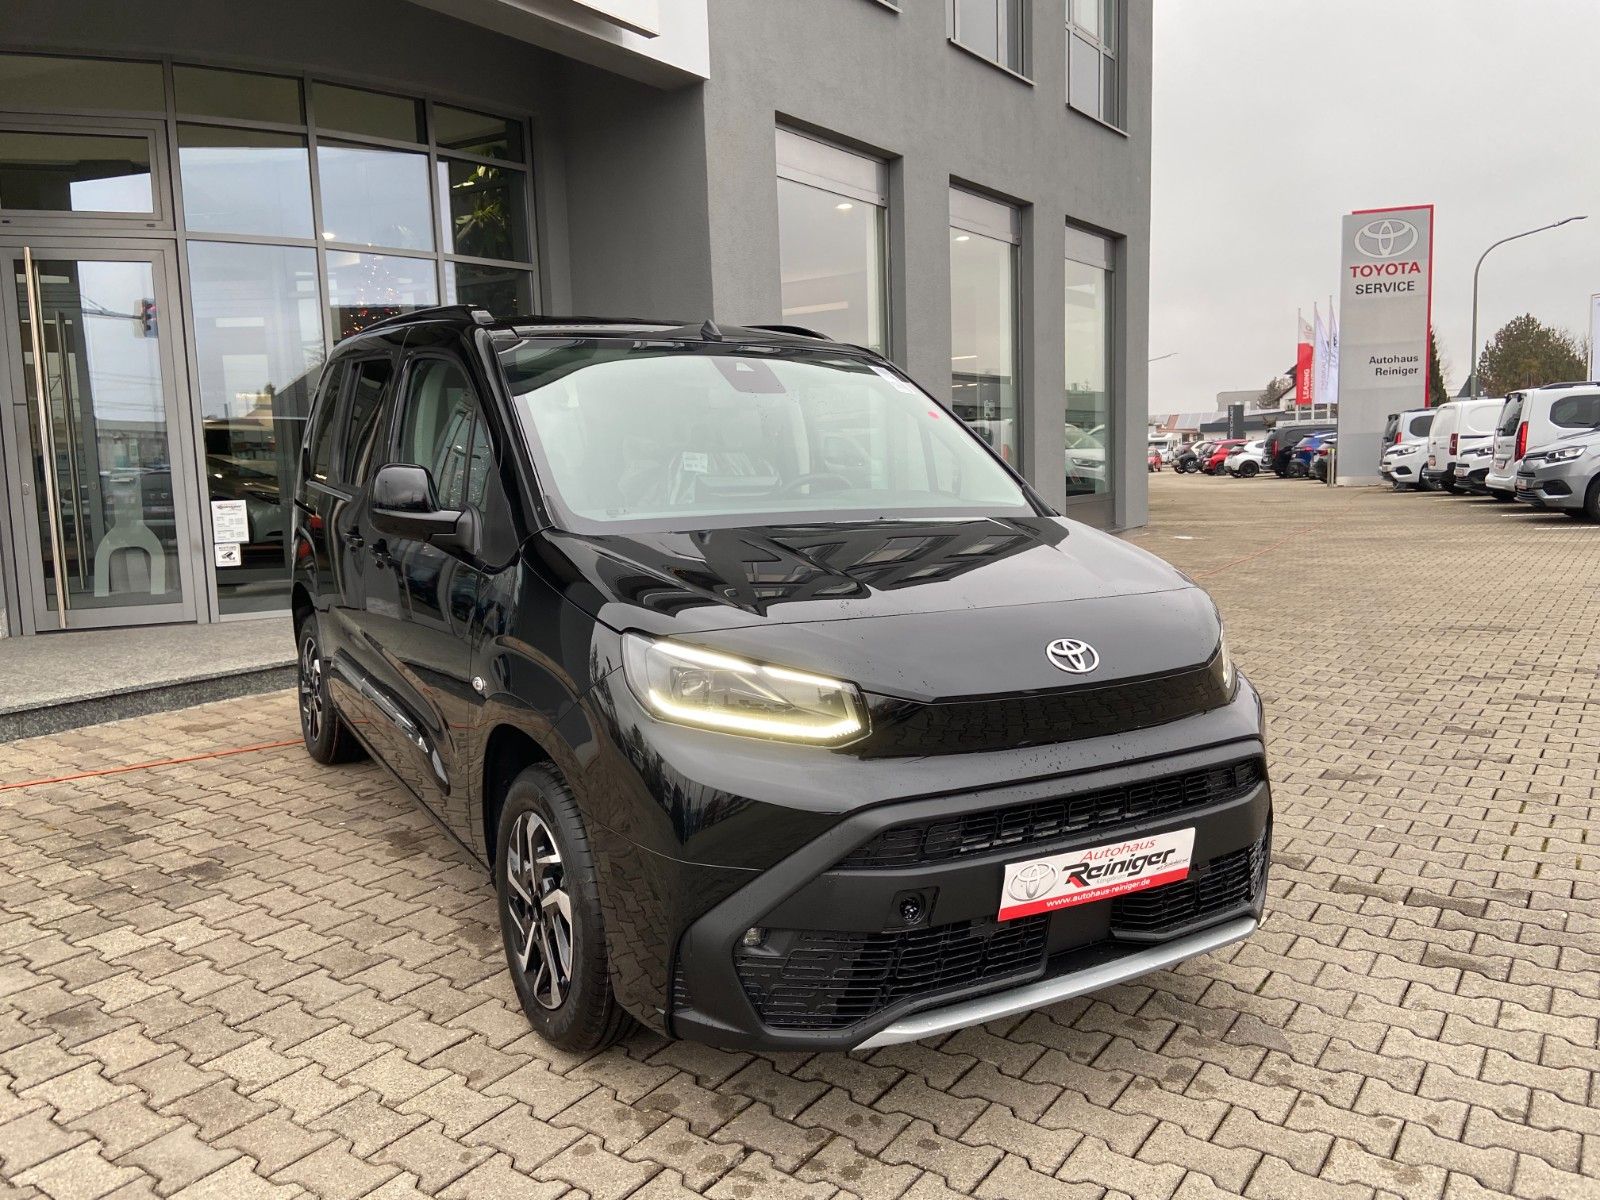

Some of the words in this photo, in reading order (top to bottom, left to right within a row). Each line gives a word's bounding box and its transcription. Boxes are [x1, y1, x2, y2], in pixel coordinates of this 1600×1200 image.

[1349, 261, 1421, 278] TOYOTA
[1355, 280, 1415, 295] SERVICE
[1368, 354, 1419, 365] Autohaus
[1375, 366, 1419, 377] Reiniger
[1080, 839, 1157, 862] Autohaus
[1061, 848, 1176, 889] Reiniger
[1046, 878, 1151, 907] www.autohaus-reiniger.de
